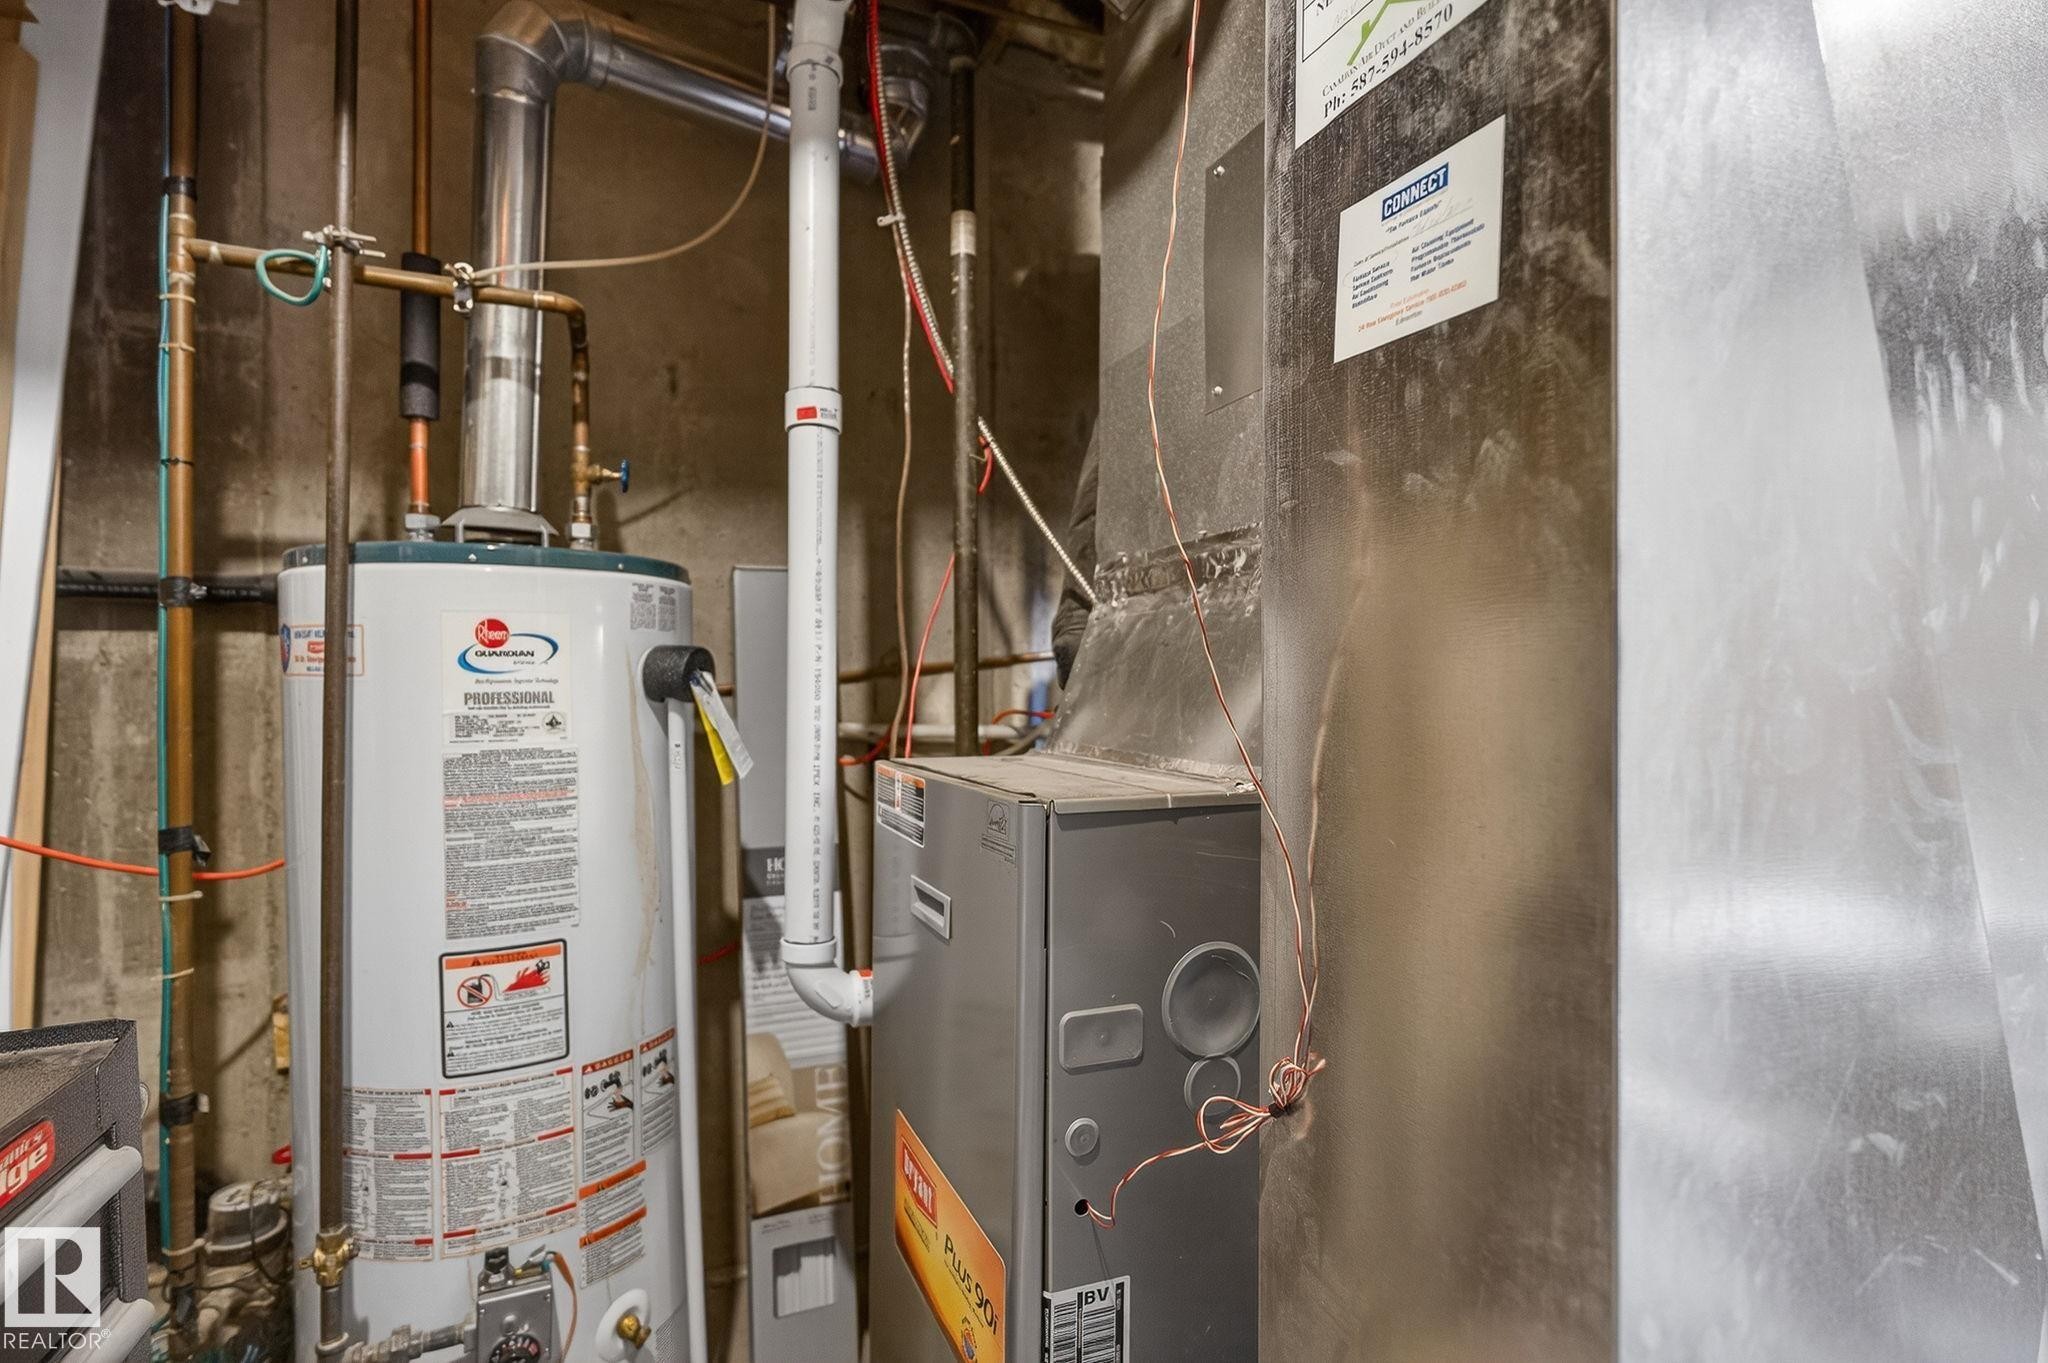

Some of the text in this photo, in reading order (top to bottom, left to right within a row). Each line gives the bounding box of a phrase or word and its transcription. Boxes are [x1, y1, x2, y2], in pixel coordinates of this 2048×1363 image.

[1324, 91, 1346, 118] Ph:
[1350, 3, 1453, 97] 587-594-8570
[1383, 166, 1448, 218] CONNECT
[475, 650, 535, 658] GUARDIAN
[477, 619, 509, 645] Rheem
[464, 691, 555, 706] PROFESSIONAL
[814, 1065, 850, 1205] HOME
[903, 1148, 933, 1214] bryant
[975, 1281, 999, 1335] 90i
[1084, 1287, 1110, 1306] BV
